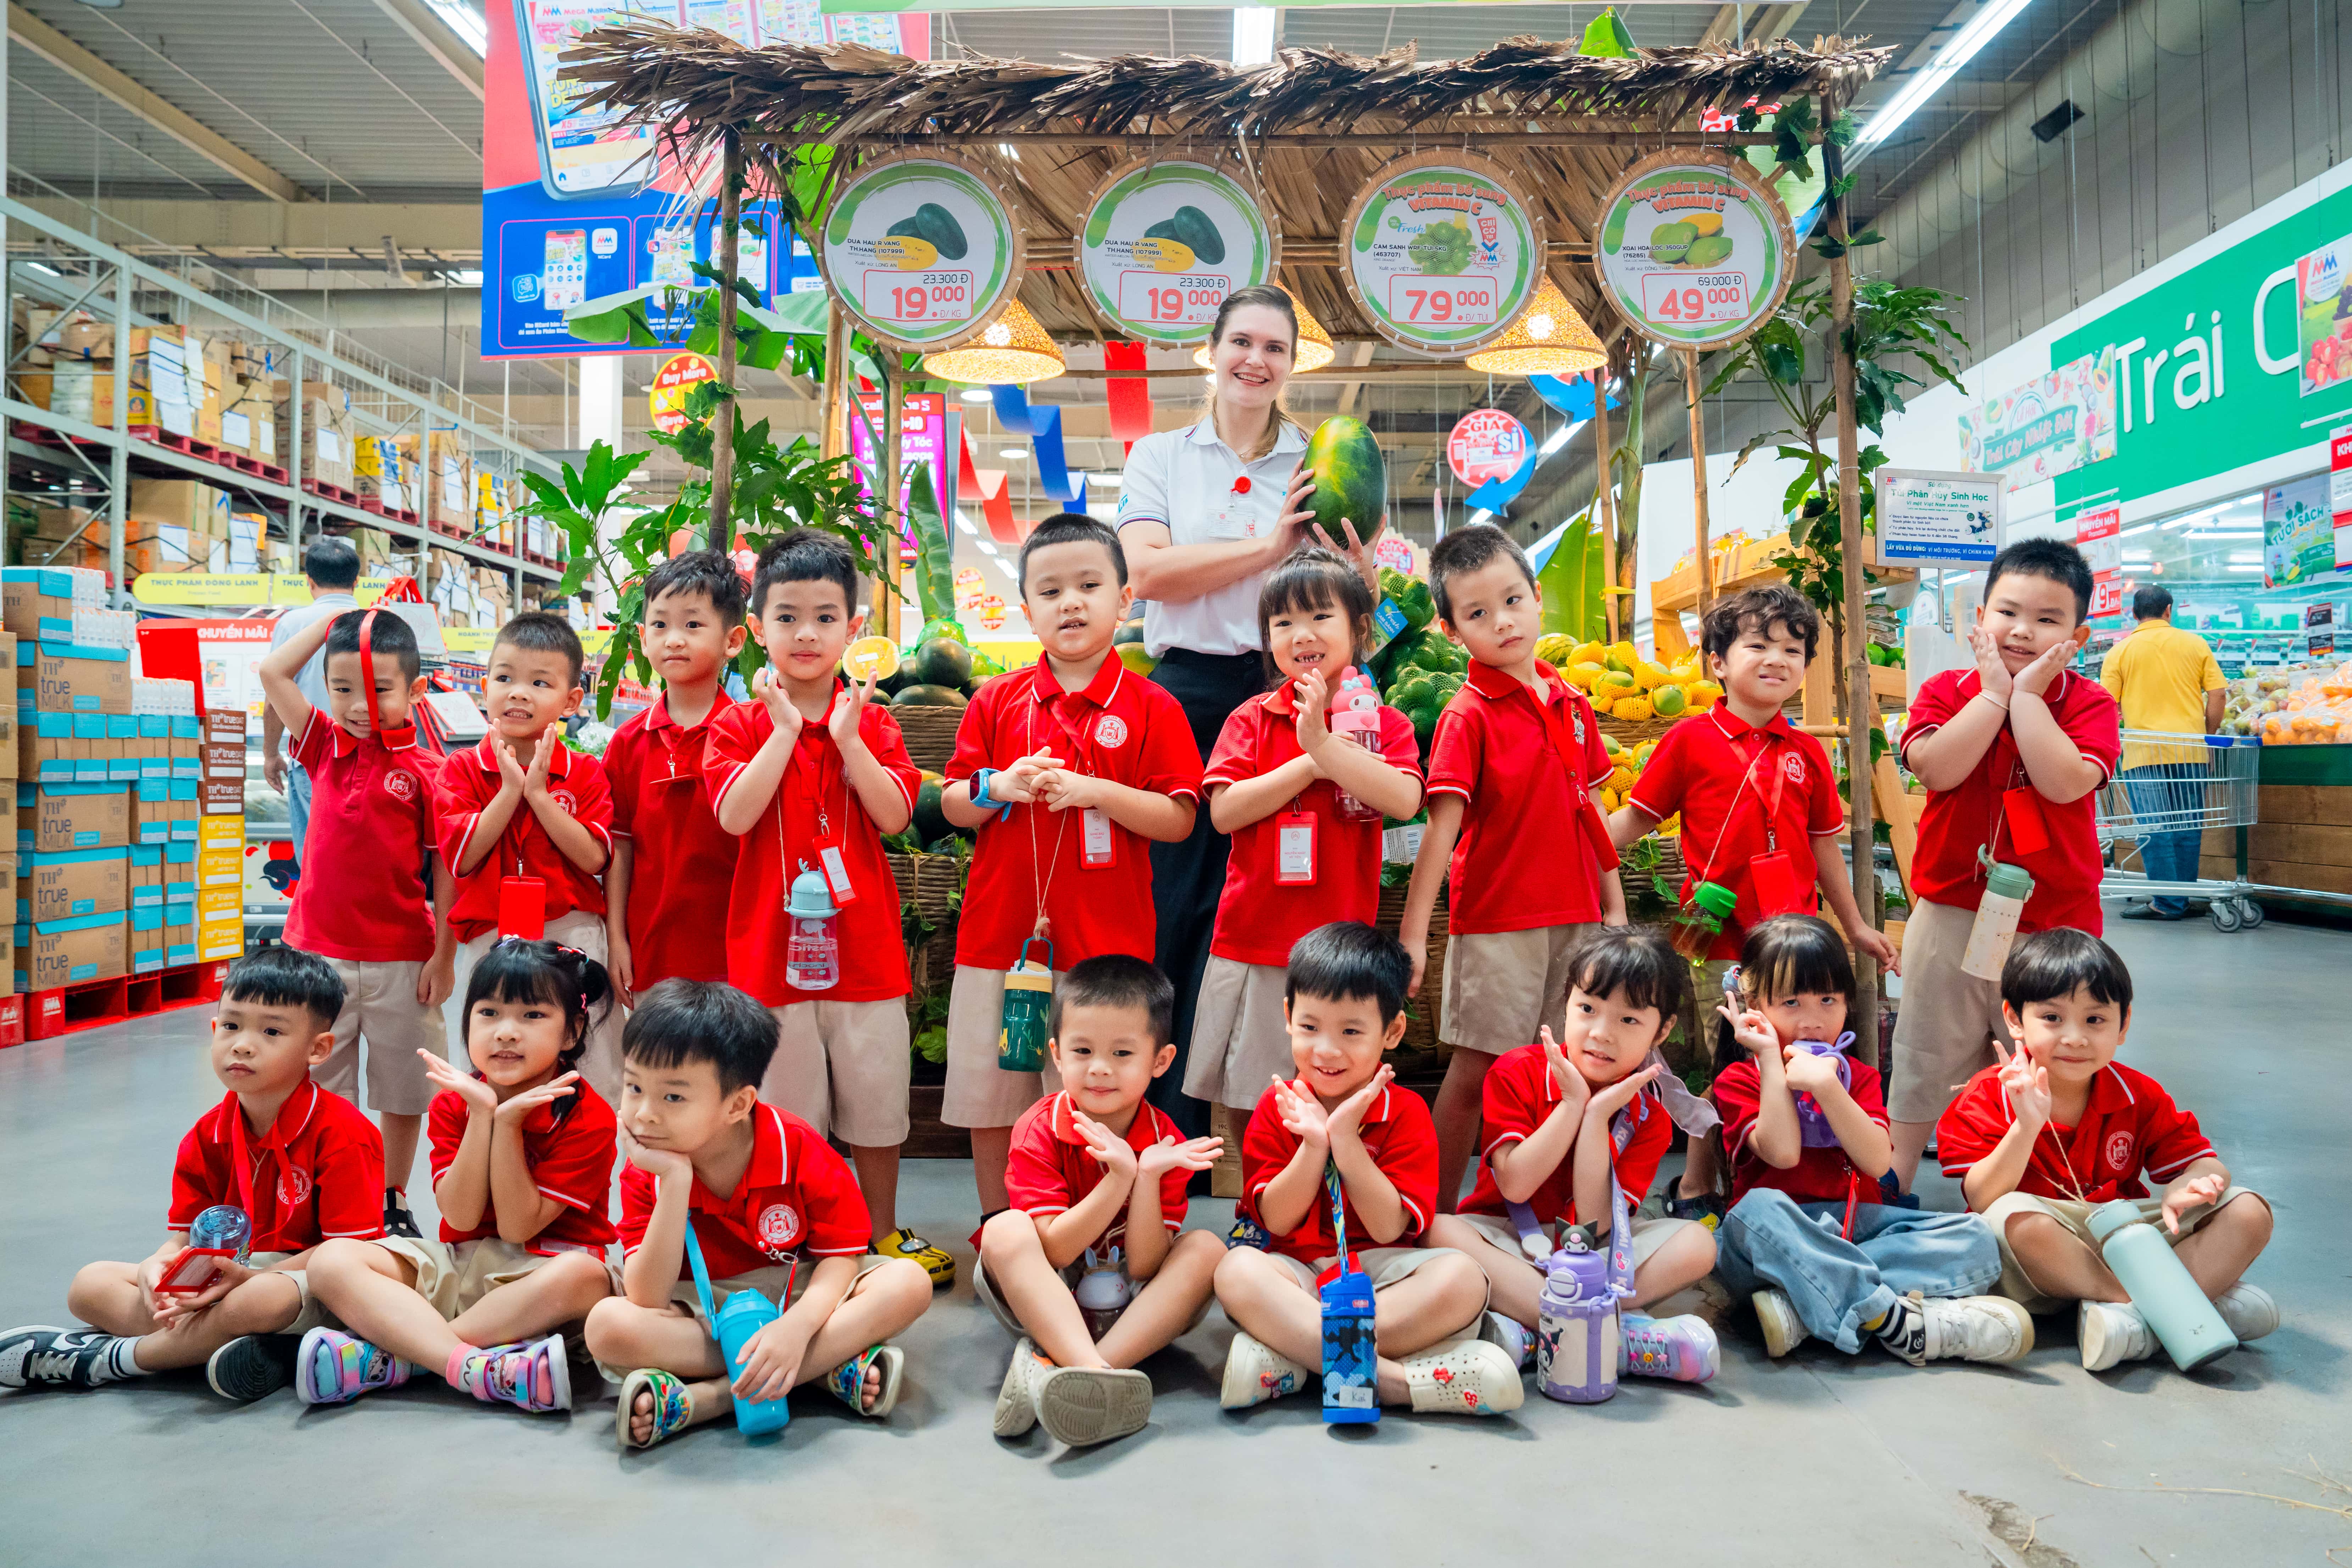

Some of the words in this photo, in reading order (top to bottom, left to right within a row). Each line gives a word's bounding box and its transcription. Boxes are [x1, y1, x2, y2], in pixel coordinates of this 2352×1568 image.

[546, 78, 588, 94] TUN
[1381, 185, 1415, 201] Thực
[1475, 188, 1508, 206] sung
[1625, 187, 1658, 204] Thực
[1408, 195, 1471, 212] VITAMIN
[1471, 201, 1483, 216] C
[1651, 195, 1713, 213] VITAMIN
[1714, 198, 1726, 212] C
[1397, 222, 1426, 233] Fresh
[923, 274, 958, 284] 23.300
[960, 274, 968, 284] Đ
[1180, 277, 1215, 288] 23.300
[1217, 279, 1225, 288] Đ
[1698, 276, 1731, 286] 69.000
[1734, 275, 1741, 284] Đ
[932, 286, 965, 302] 000
[1188, 290, 1222, 306] 000
[1457, 290, 1490, 306] 000
[1707, 287, 1740, 304] 000
[951, 310, 961, 318] KG
[1729, 309, 1740, 318] KG
[662, 373, 681, 385] Buy
[682, 367, 707, 381] More
[2115, 310, 2225, 433] Trái
[661, 415, 684, 427] Save
[912, 436, 933, 447] Tóc
[2005, 438, 2023, 459] Cây
[1907, 490, 1929, 498] Phân
[1951, 492, 1969, 500] Sinh
[1972, 493, 1989, 503] Học
[2079, 515, 2104, 533] KHUYẾN
[2104, 513, 2116, 526] MÃI
[2297, 505, 2324, 528] SẠCH
[197, 623, 243, 639] KHUYẾN
[244, 624, 268, 638] MÃI
[40, 676, 70, 695] true
[41, 694, 71, 710] MILK
[1118, 718, 1127, 732] SCHOOL
[42, 817, 72, 834] true
[43, 833, 71, 848] MILK
[38, 887, 68, 904] true
[38, 903, 67, 918] MILK
[36, 954, 69, 972] true
[37, 970, 68, 986] MILK
[760, 1205, 782, 1221] AUSTRALIAN
[783, 1205, 797, 1217] SCHOOL
[1616, 1197, 1629, 1248] KUROMI
